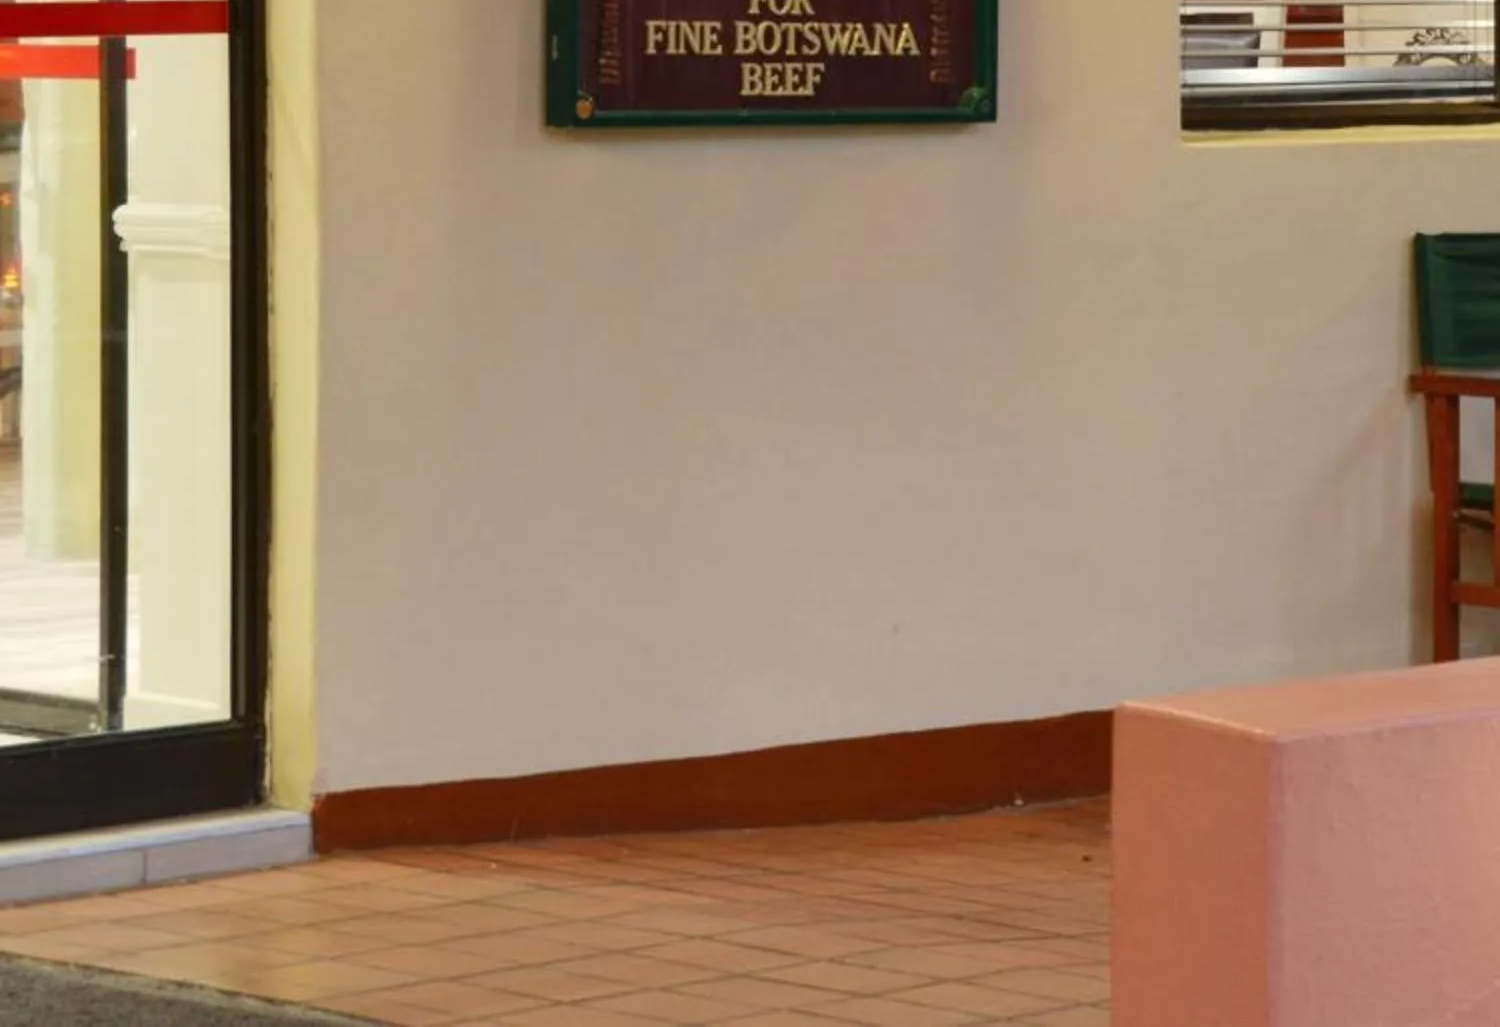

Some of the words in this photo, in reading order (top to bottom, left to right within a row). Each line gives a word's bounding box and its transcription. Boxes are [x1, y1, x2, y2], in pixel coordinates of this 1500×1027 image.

[645, 20, 723, 56] FINE
[734, 20, 920, 57] BOTSWANA
[740, 62, 825, 97] BEEF
